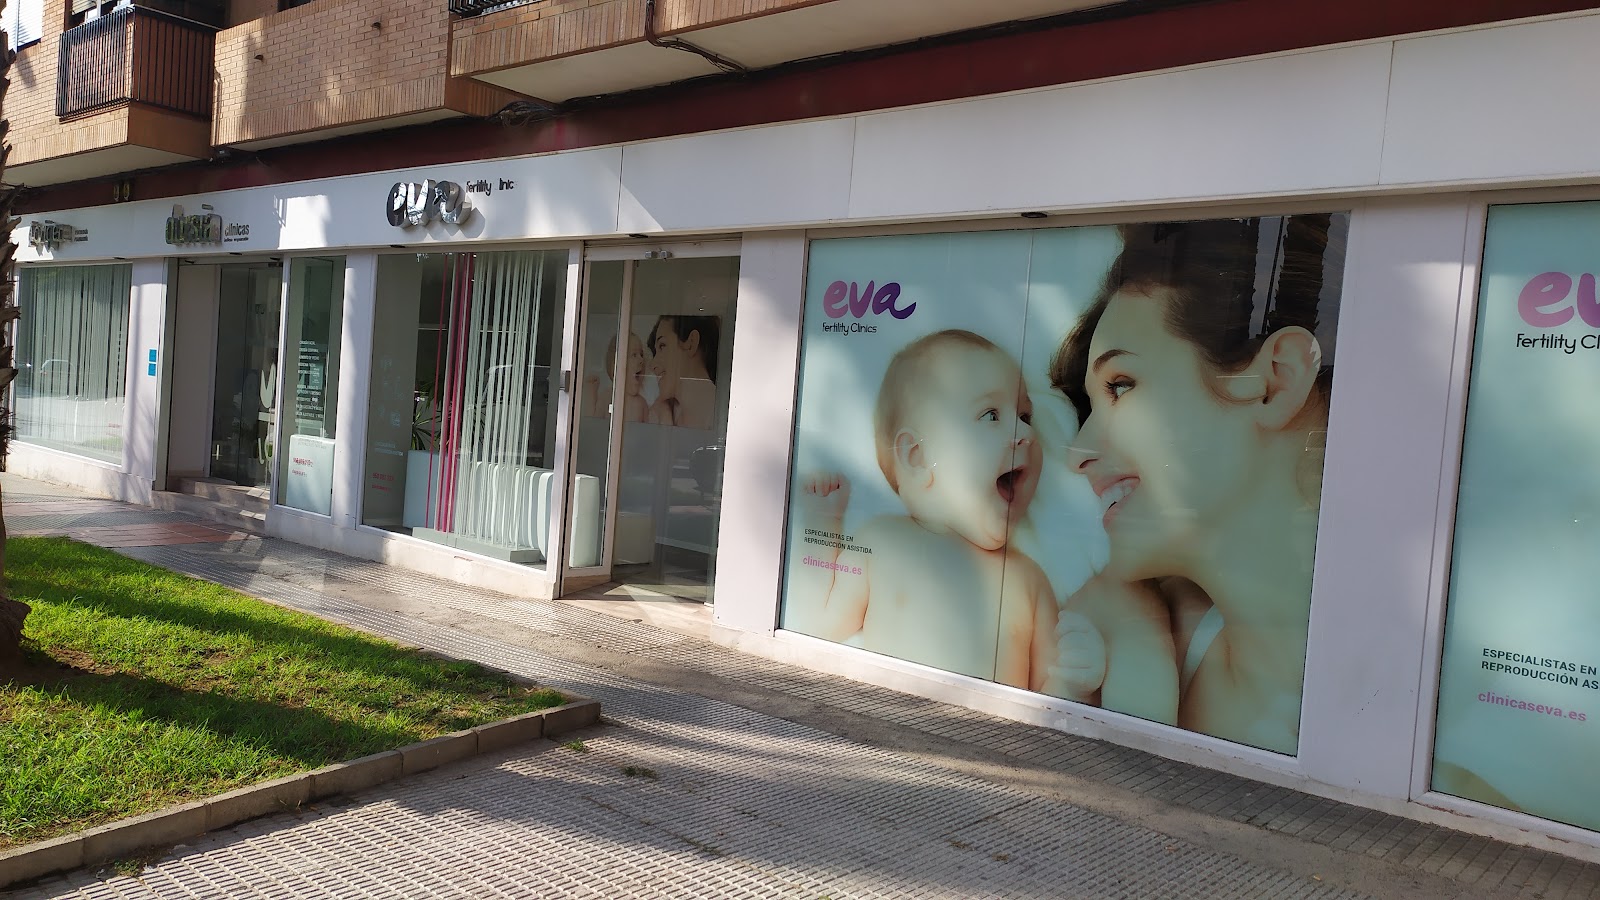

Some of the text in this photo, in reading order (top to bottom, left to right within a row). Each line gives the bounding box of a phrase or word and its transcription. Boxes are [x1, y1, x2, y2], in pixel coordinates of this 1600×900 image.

[823, 280, 917, 319] eva
[822, 322, 877, 336] Fertility Clinics
[1516, 333, 1577, 354] Fertility
[804, 528, 845, 541] ESPECIALISTAS
[846, 544, 873, 555] ASISTIDA
[802, 555, 863, 576] clinicaseva.es
[1482, 648, 1597, 676] ESPECIALISTAS EN
[1481, 660, 1600, 690] REPRODUCCIÓN AS
[1478, 691, 1587, 722] clinicaseva.es
